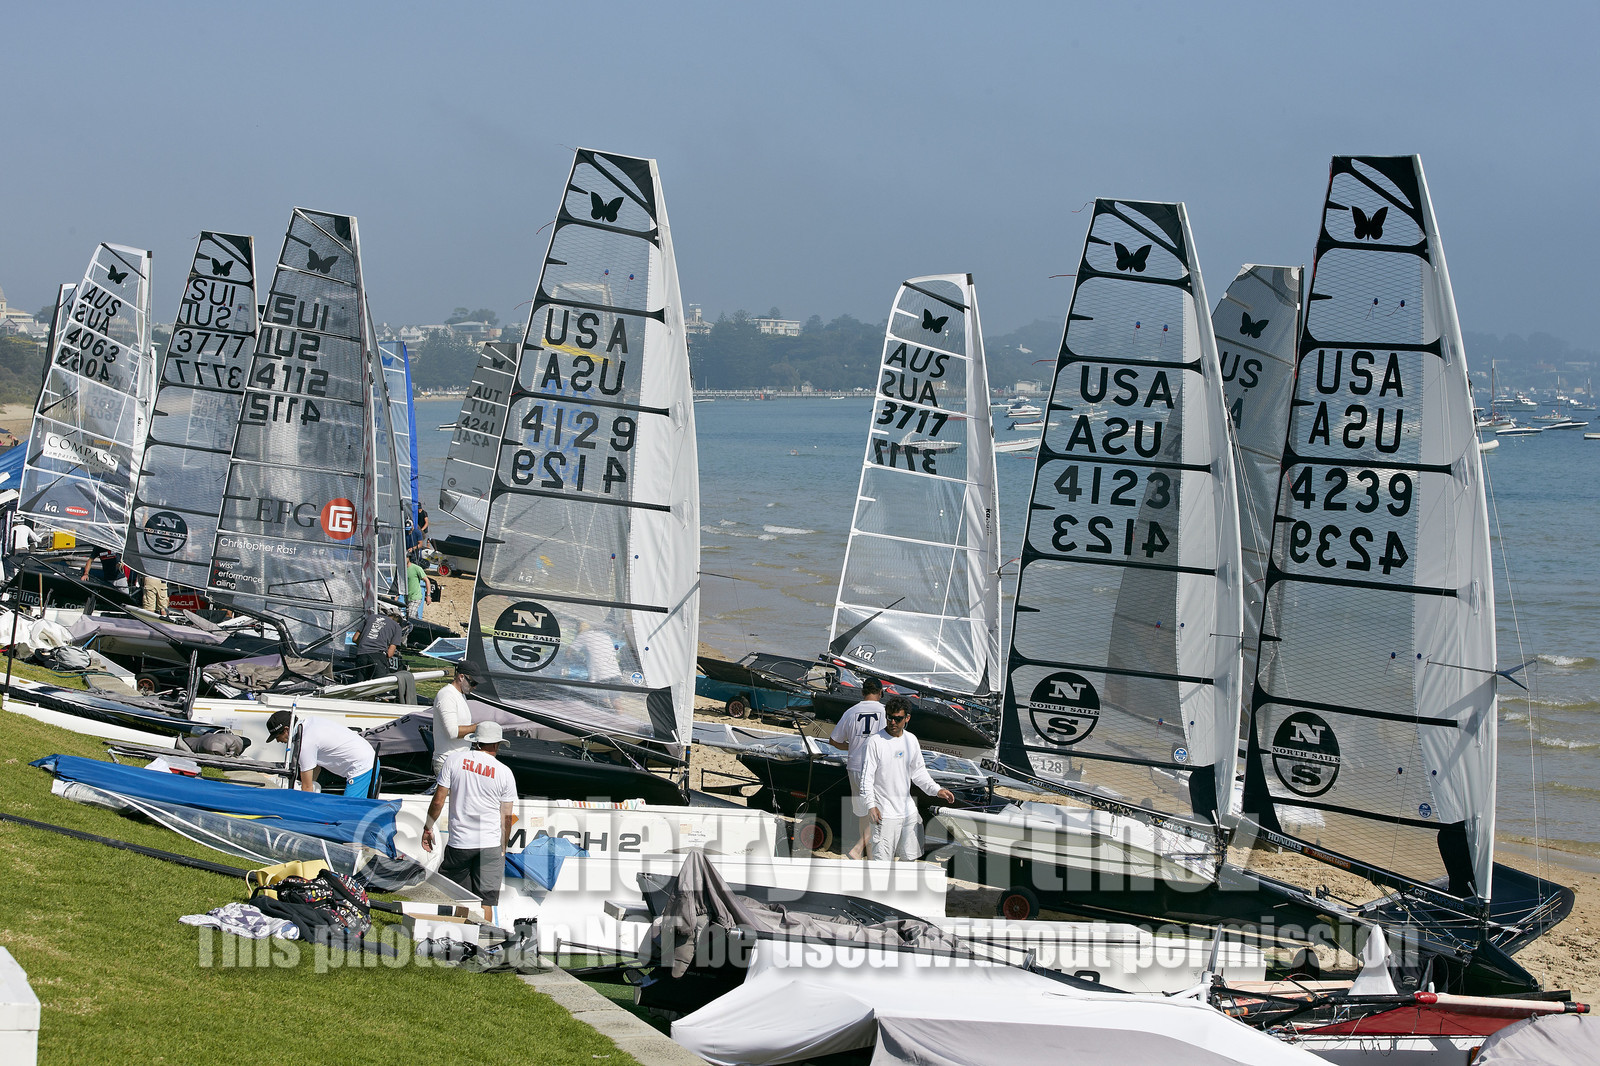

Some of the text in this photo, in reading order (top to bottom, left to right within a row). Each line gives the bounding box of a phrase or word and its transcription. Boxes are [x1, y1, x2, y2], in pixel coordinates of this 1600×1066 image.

[81, 286, 122, 317] AUS
[273, 297, 329, 331] SUI
[545, 308, 629, 353] USA
[66, 328, 120, 363] 4063
[177, 330, 246, 358] 3777
[886, 343, 950, 378] AUS
[1221, 351, 1263, 388] US
[256, 363, 329, 397] 4112
[1316, 350, 1404, 397] USA
[473, 386, 502, 402] AUT
[1080, 365, 1175, 409] USA
[461, 415, 495, 435] 4241
[521, 405, 636, 452] 4129
[876, 402, 949, 437] 3717
[48, 435, 117, 467] COMPASS
[1053, 465, 1171, 509] 4123
[1291, 466, 1413, 517] 4239
[255, 498, 317, 528] EFG
[220, 537, 297, 555] Christopher Rast
[212, 578, 237, 590] Sailing
[213, 569, 263, 584] Performance
[512, 609, 547, 628] N
[493, 630, 561, 643] NORTH SAILS
[511, 644, 542, 663] S
[855, 645, 876, 663] ka.
[1048, 680, 1087, 700] N
[1029, 702, 1100, 716] NORTH SAILS
[1046, 717, 1079, 735] S
[1289, 720, 1326, 745] N
[1272, 746, 1341, 763] NORTH SAILS
[462, 758, 496, 779] SLAM
[1291, 764, 1321, 786] S
[619, 833, 641, 852] 2
